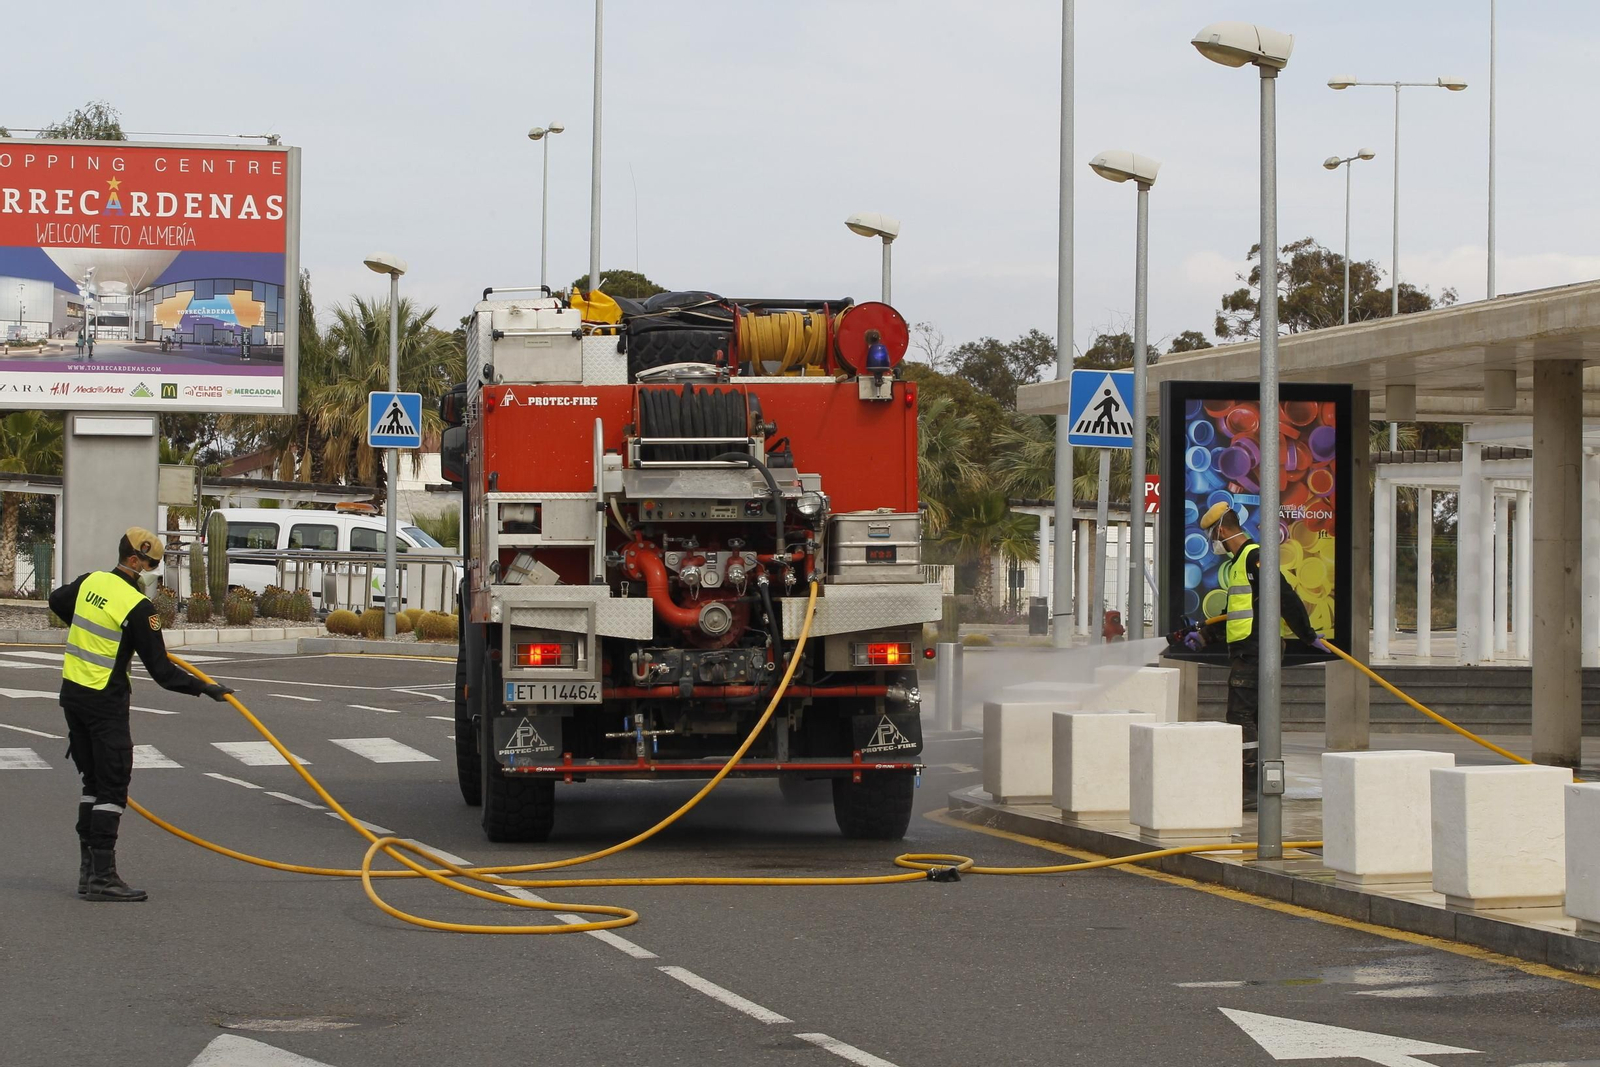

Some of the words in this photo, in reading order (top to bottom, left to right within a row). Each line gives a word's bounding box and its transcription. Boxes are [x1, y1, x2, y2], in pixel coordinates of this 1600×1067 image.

[155, 158, 282, 175] CENTRE
[36, 223, 101, 244] WELCOME
[110, 225, 131, 245] TO
[138, 222, 196, 246] ALMERÍA
[528, 397, 598, 406] PROTEC-FIRE
[1279, 509, 1333, 519] ATENCIÓN
[85, 591, 108, 609] UME
[517, 684, 536, 700] ET
[542, 684, 598, 700] 114464
[499, 746, 555, 756] PROTEC-FIRE
[861, 743, 917, 753] PROTEC-FIRE
